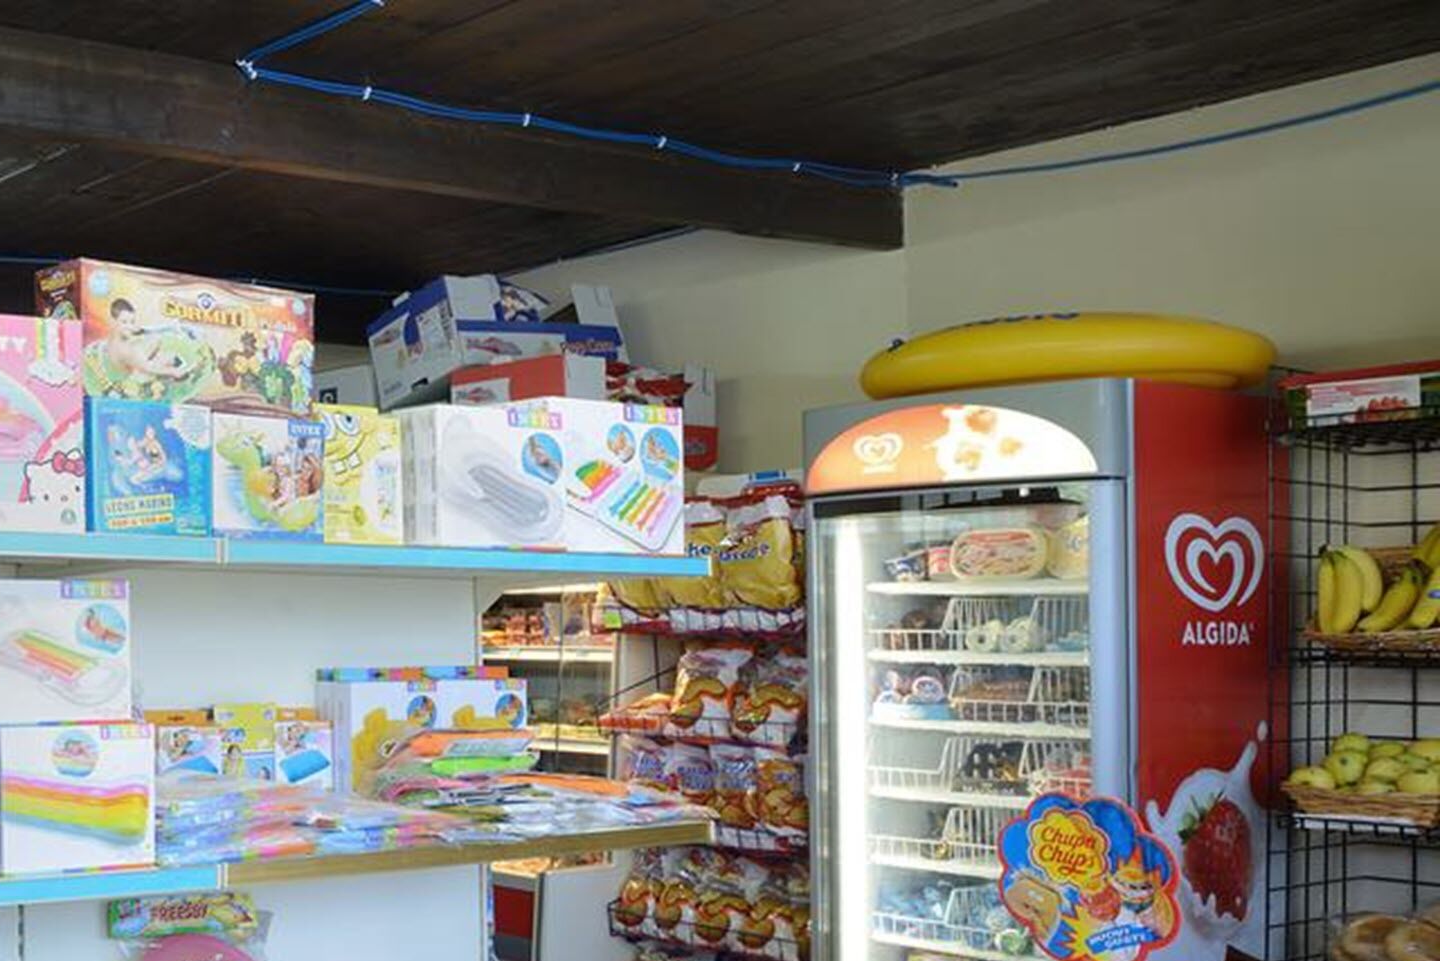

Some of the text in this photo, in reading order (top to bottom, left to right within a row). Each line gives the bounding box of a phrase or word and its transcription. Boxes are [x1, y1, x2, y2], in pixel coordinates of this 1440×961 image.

[1181, 620, 1251, 645] ALGIDA
[1041, 826, 1095, 850] Chupa
[1039, 844, 1094, 876] Chups
